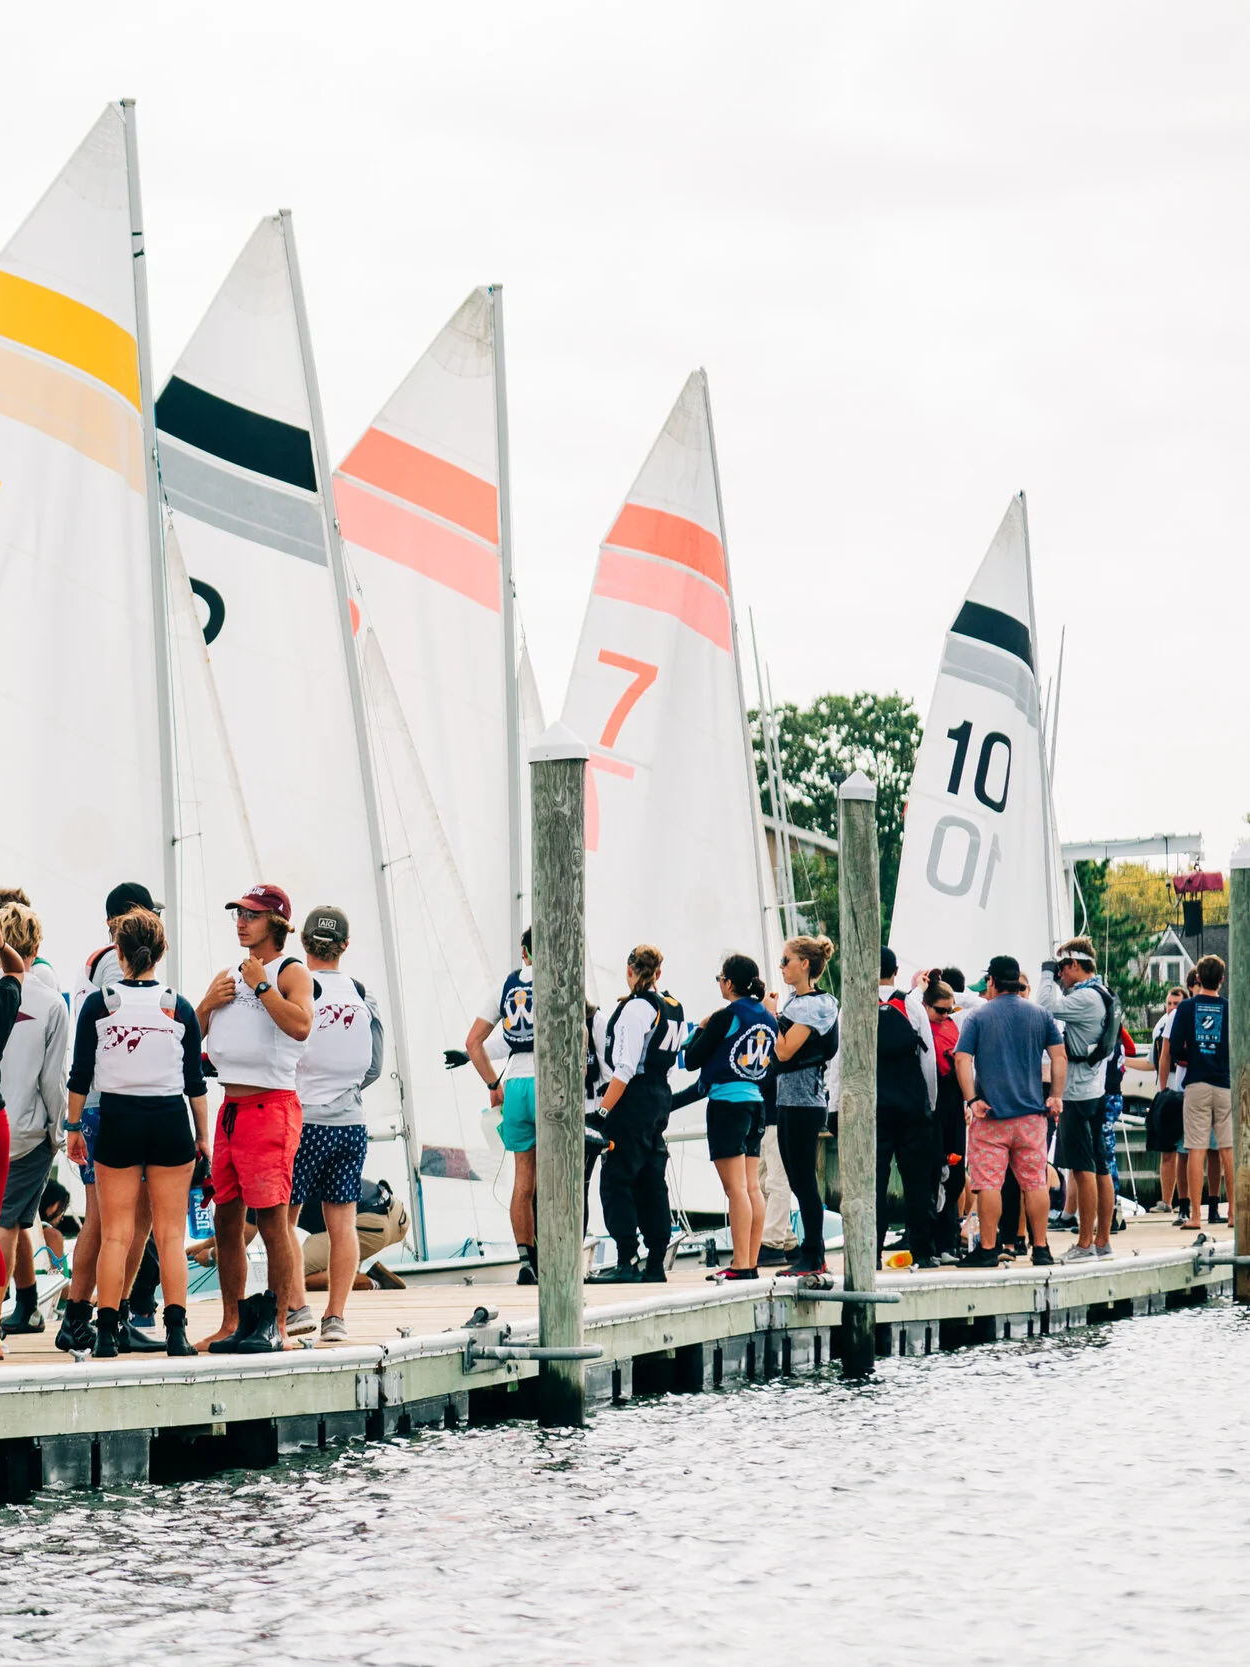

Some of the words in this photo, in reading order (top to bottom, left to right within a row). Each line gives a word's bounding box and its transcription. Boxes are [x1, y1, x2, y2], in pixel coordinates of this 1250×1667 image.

[597, 648, 659, 749] 7
[947, 719, 1012, 814] 10
[320, 919, 335, 928] AIG
[747, 1038, 771, 1066] W
